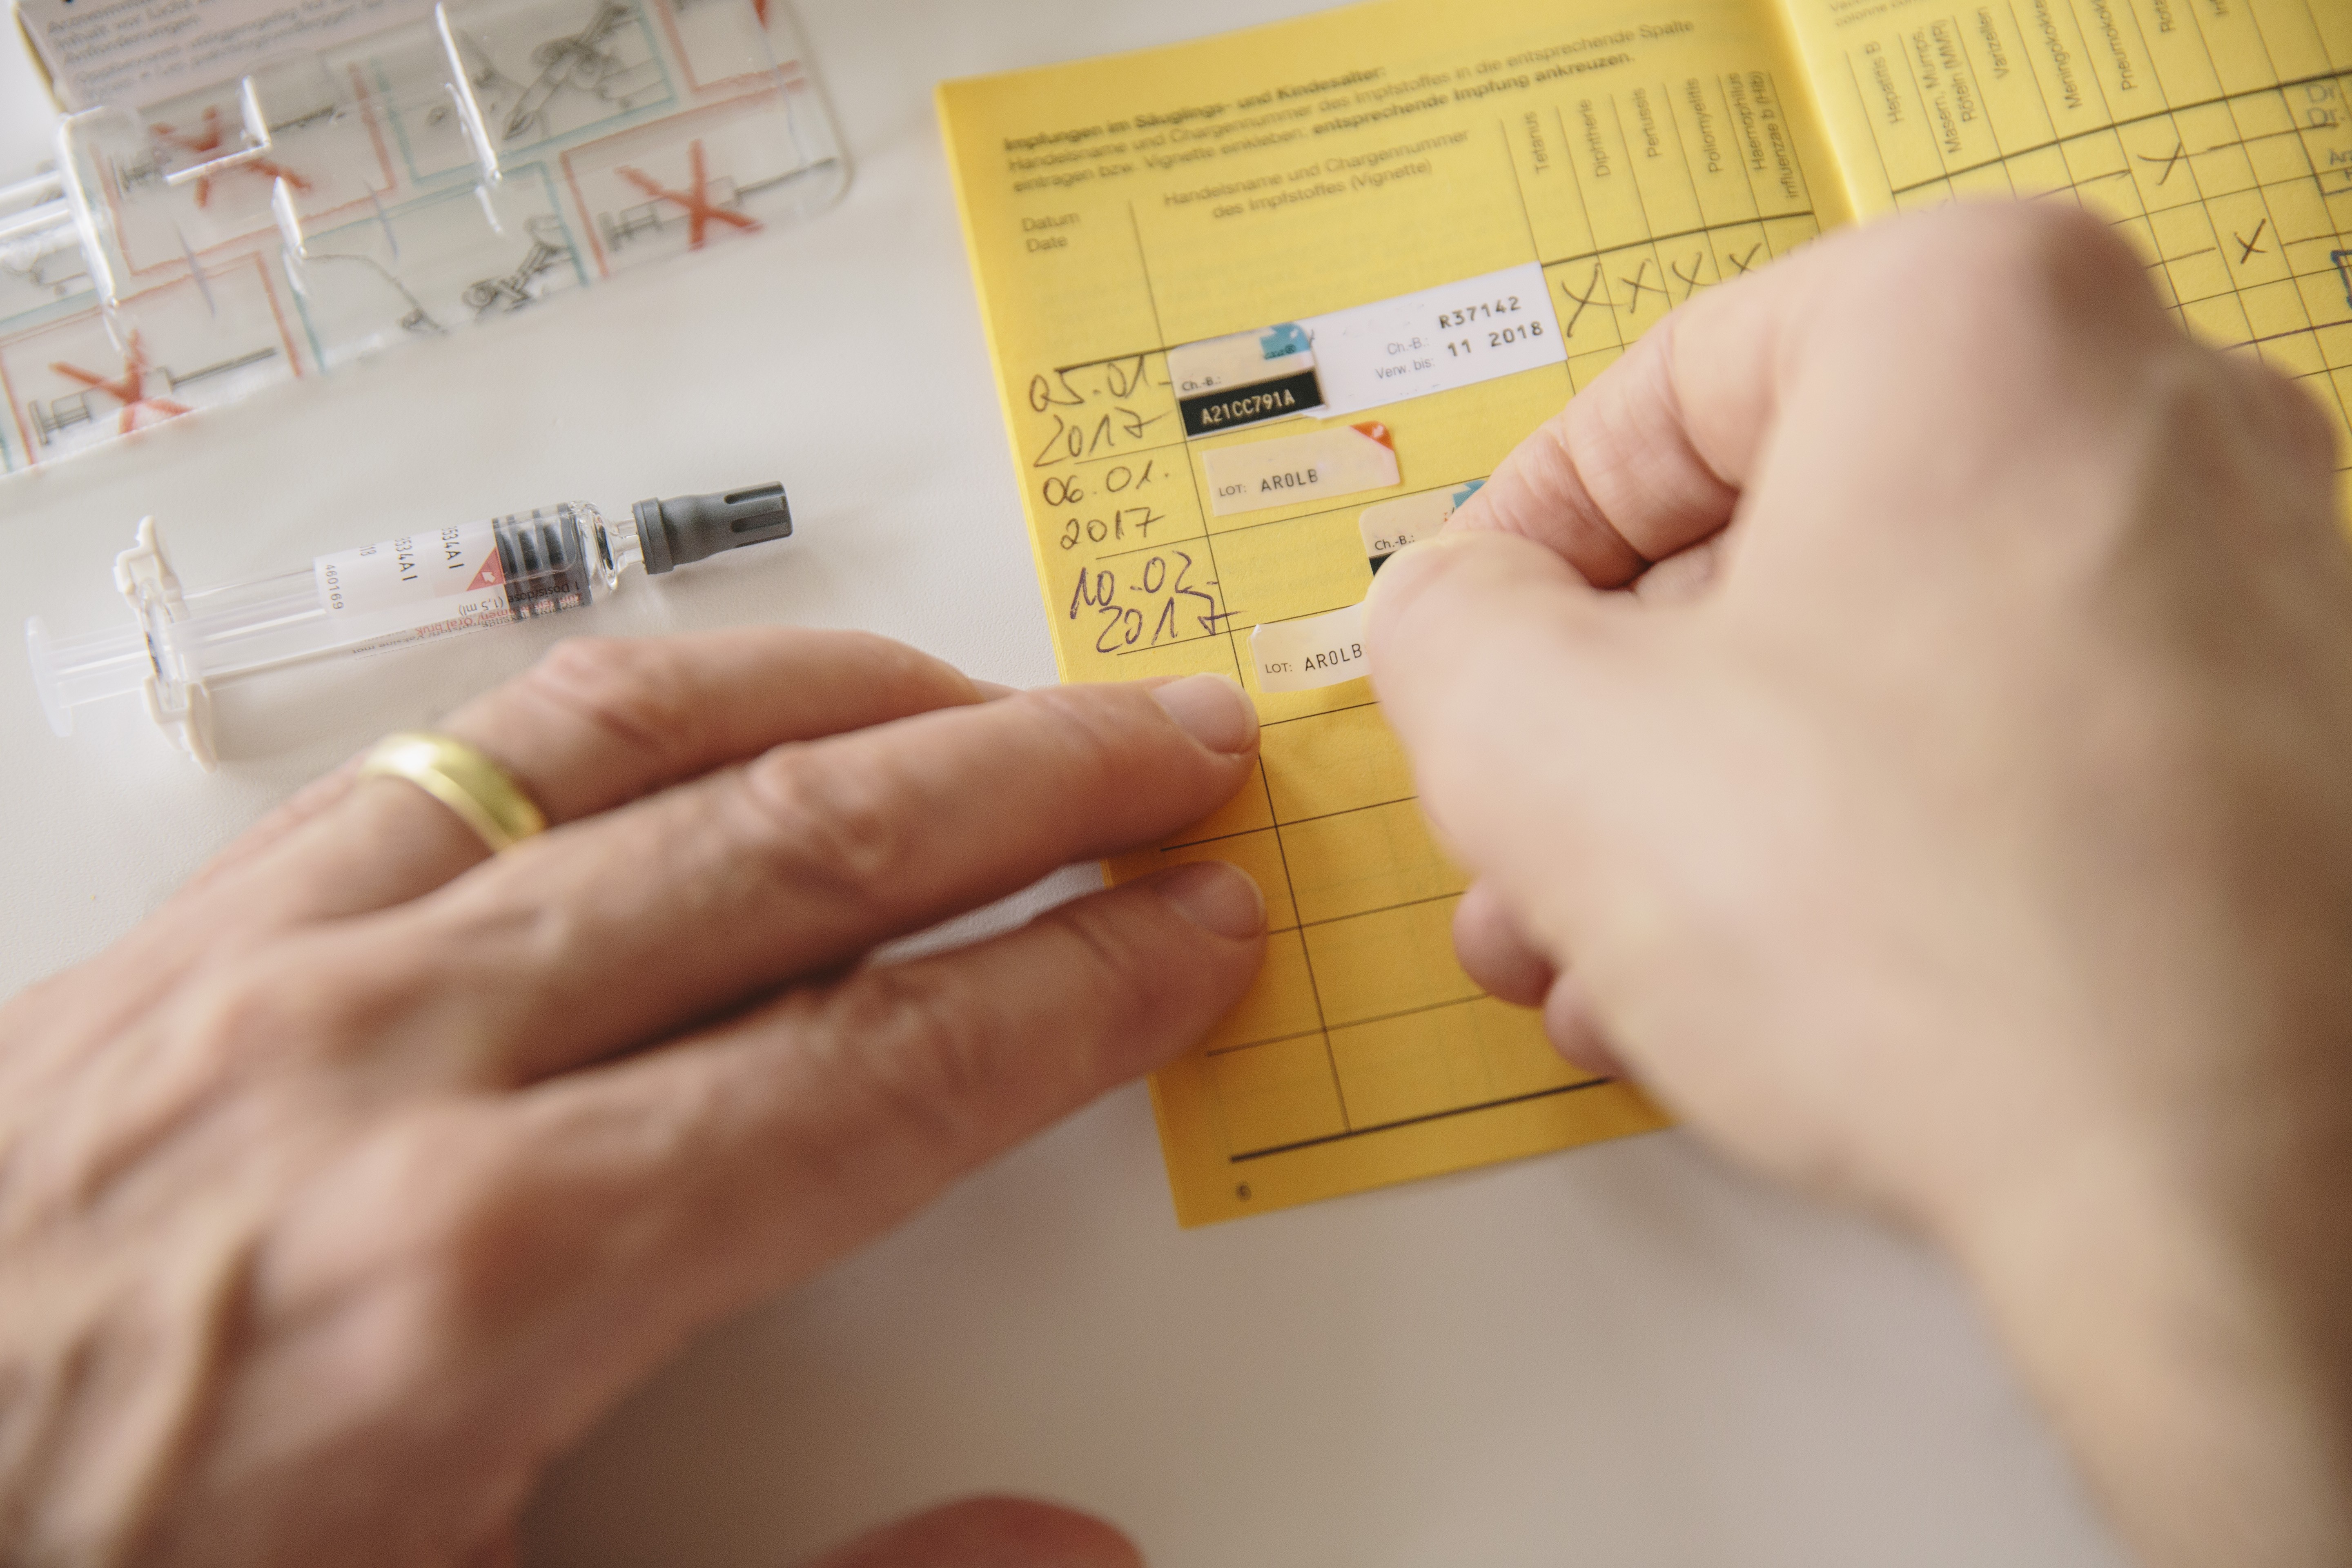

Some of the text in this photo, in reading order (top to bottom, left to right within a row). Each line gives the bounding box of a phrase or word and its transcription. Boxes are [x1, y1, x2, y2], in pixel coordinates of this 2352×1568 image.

[1977, 6, 2009, 80] Varizellen
[1008, 20, 1695, 172] Handelsname und Chargennummer des Impfstoffes in die entsprechende Spalte
[1864, 40, 1904, 125] Hepatitis B
[1912, 27, 1962, 154] Masern, Mumps,
[1952, 72, 1978, 123] Röteln
[1004, 124, 1103, 151] Impfungen
[1134, 101, 1231, 131] Säuglings-
[1237, 91, 1271, 109] und
[1013, 168, 1095, 192] eintragen
[1144, 147, 1214, 169] Vignette
[1312, 93, 1449, 135] entsprechende
[1454, 74, 1530, 101] Impfung
[1535, 52, 1636, 82] ankreuzen.
[1524, 110, 1550, 174] Tetanus
[1577, 98, 1610, 178] Diphtherie
[1633, 87, 1663, 158] Pertussis
[1684, 77, 1723, 174] Poliomyelitis
[1728, 72, 1767, 172] Haemophilus
[1762, 109, 1775, 120] b
[1164, 130, 1470, 207] Handelsname und Chargennummer
[1213, 157, 1433, 219] des Impfstoffes (Vignette)
[1768, 123, 1800, 199] influenzae
[1022, 210, 1080, 232] Datum
[1026, 234, 1068, 254] Date
[1374, 320, 1544, 380] Verw. bis: 11 2018
[1387, 295, 1522, 356] Ch.-B.: R37142
[1181, 376, 1222, 391] Ch.-B.:
[1201, 388, 1296, 425] A21CC791A
[1034, 407, 1173, 468] 2017
[1218, 484, 1247, 497] LOT:
[1060, 507, 1167, 550] 2017
[1374, 535, 1415, 550] Ch.-B.:
[325, 564, 344, 610] 460169
[459, 603, 477, 616] ml)
[481, 595, 504, 610] (1,5
[352, 645, 375, 654] mot
[415, 623, 443, 636] bruk
[446, 617, 473, 630] Oral
[1096, 589, 1247, 653] 2017
[1265, 663, 1292, 673] LOT:
